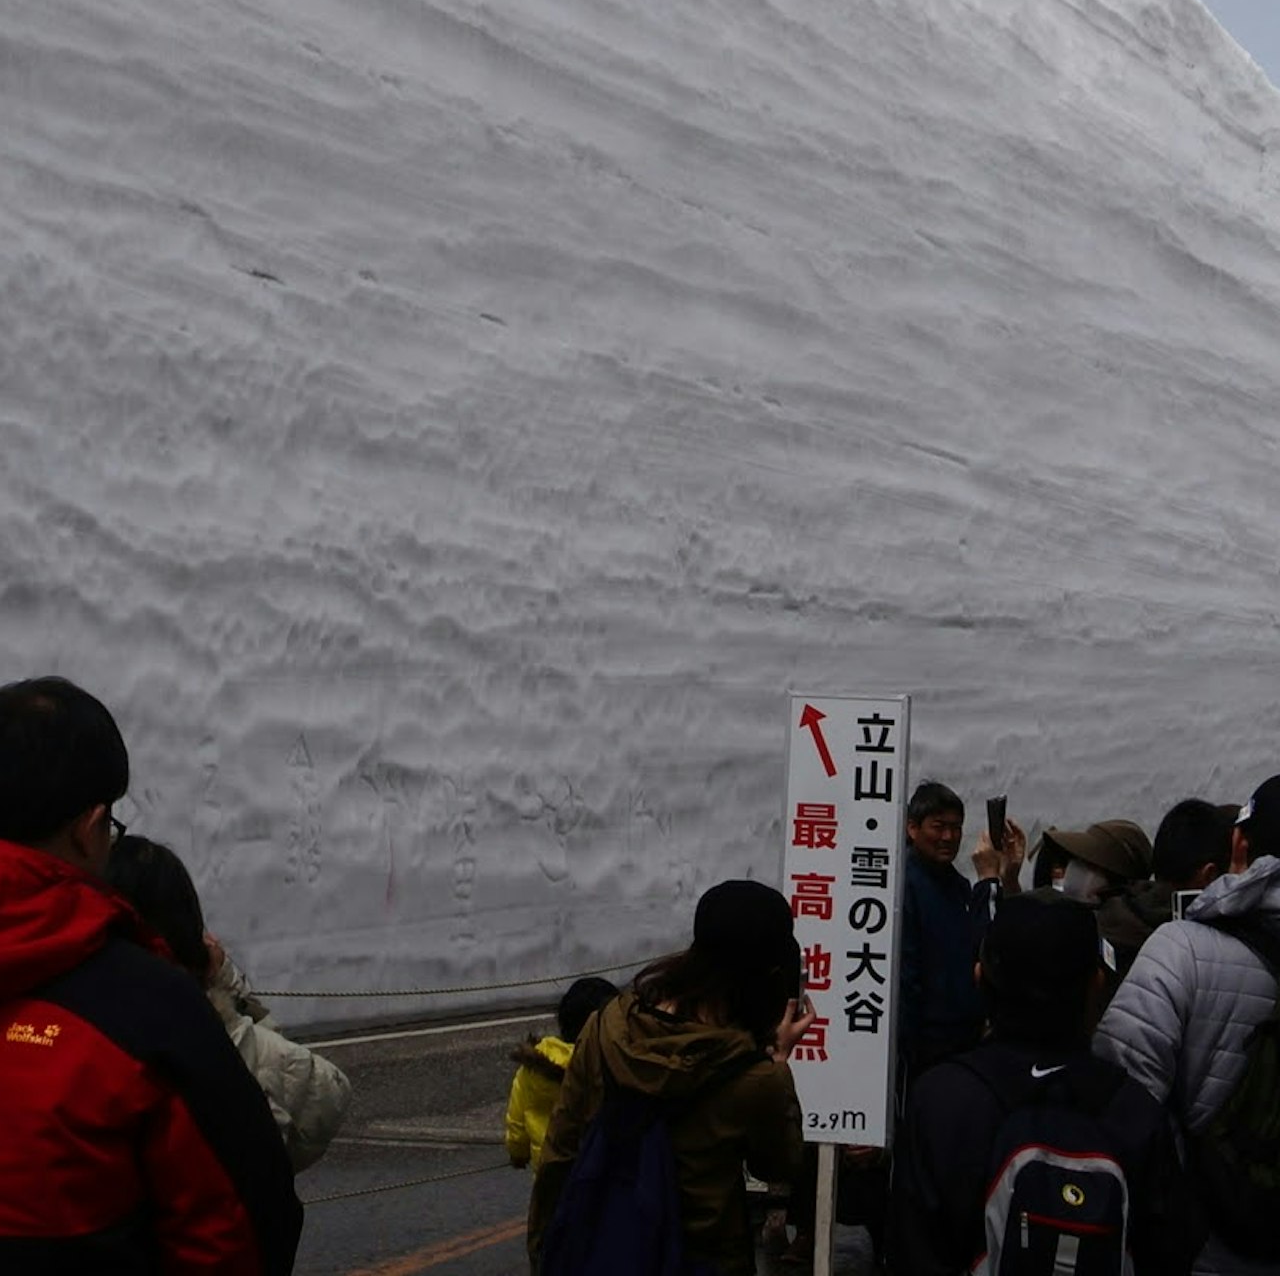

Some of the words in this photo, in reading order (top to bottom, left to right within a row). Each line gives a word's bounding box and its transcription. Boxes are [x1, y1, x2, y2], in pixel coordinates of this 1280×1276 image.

[844, 713, 895, 1034] 立山・雪の大谷
